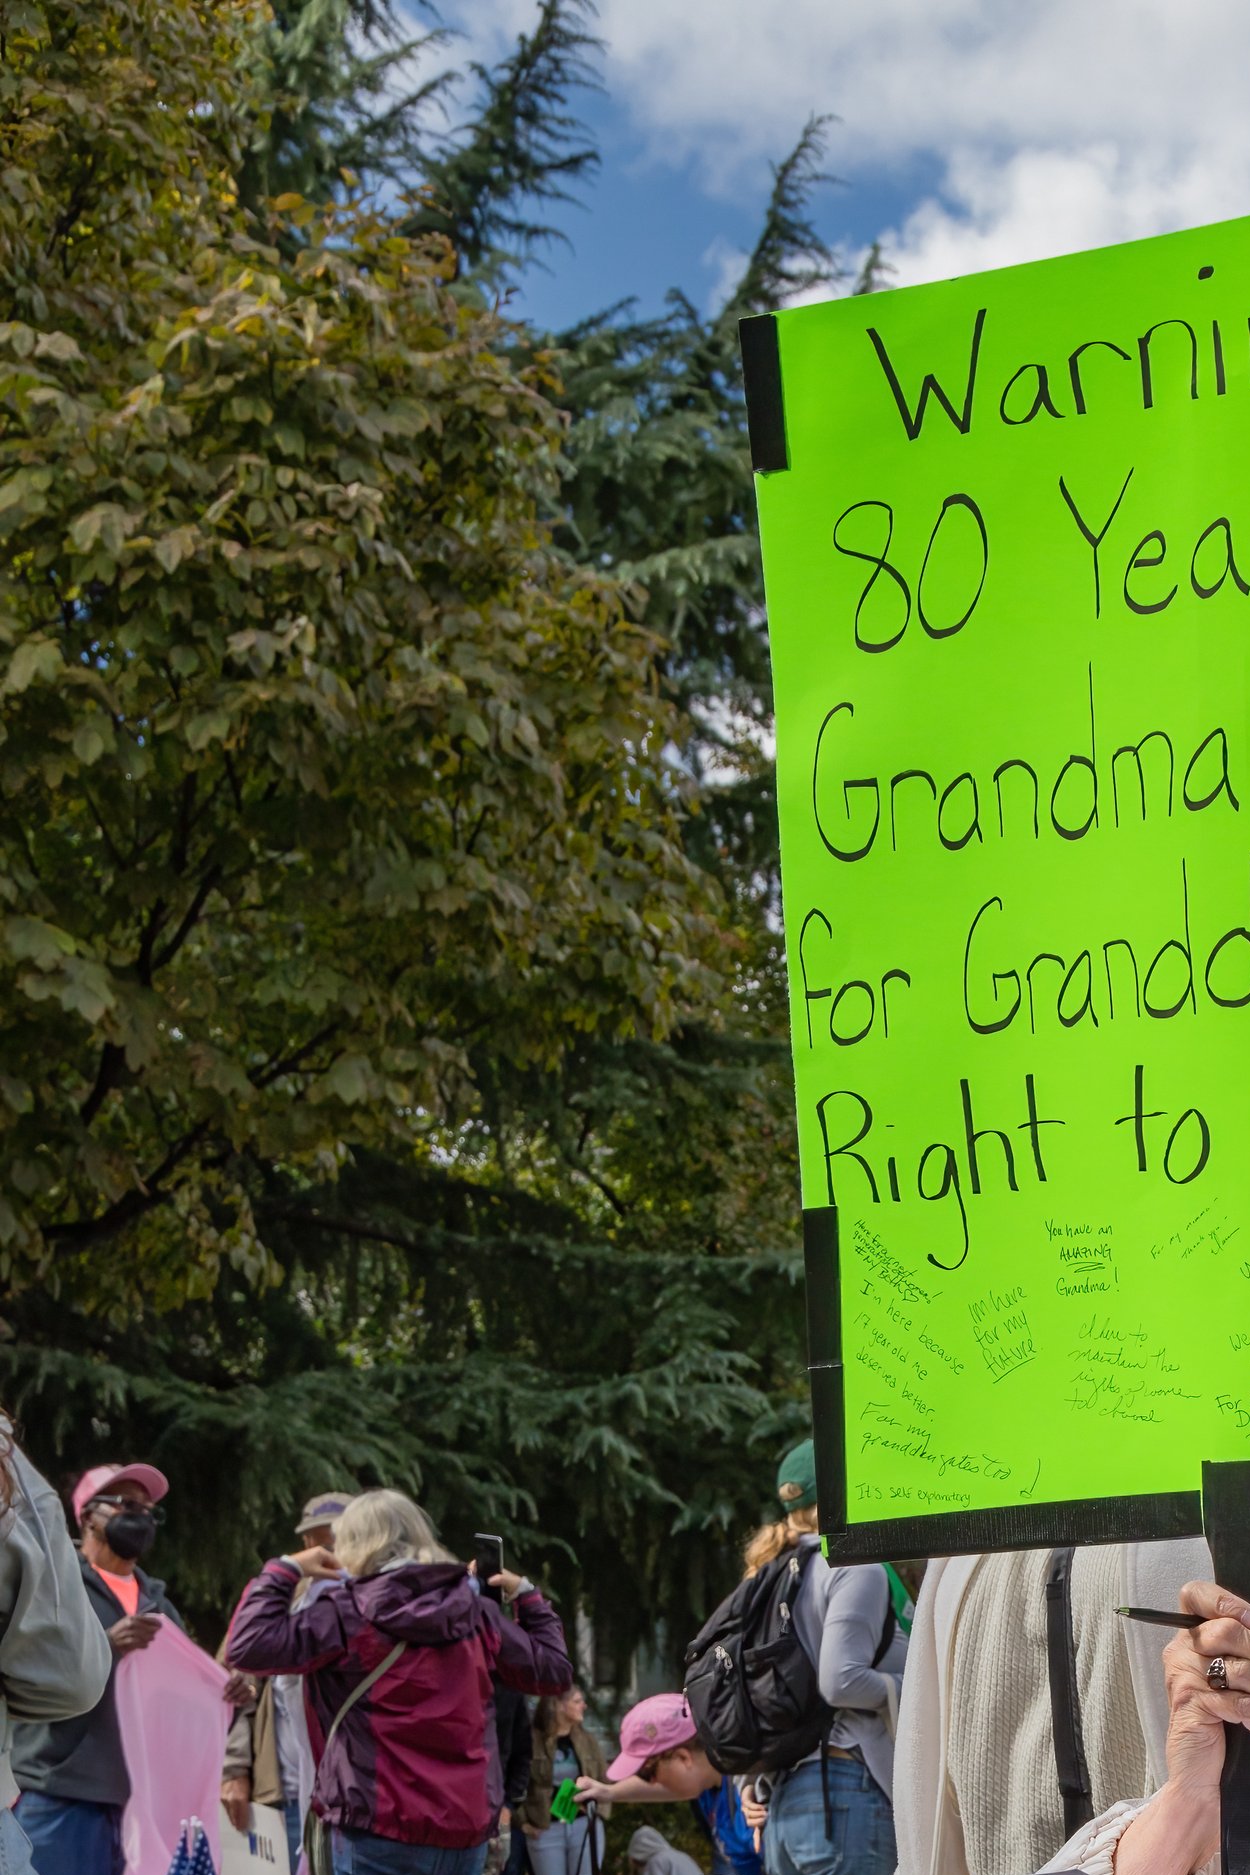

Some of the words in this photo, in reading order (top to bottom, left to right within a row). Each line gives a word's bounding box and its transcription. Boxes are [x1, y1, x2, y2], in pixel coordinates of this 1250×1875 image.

[832, 493, 988, 654] 80
[812, 661, 1240, 862] Grandma
[799, 908, 911, 1048] for
[815, 1072, 1067, 1270] Right
[1113, 1065, 1211, 1184] to
[1044, 1218, 1063, 1242] You
[1065, 1223, 1092, 1238] have
[1098, 1225, 1112, 1235] an
[1059, 1243, 1112, 1262] AMAZING
[989, 1285, 1027, 1312] here
[1056, 1267, 1120, 1296] Grandma!
[886, 1298, 912, 1331] here
[918, 1325, 965, 1375] because
[1003, 1309, 1032, 1337] my
[868, 1327, 890, 1348] year
[891, 1346, 907, 1363] old
[912, 1362, 928, 1380] me
